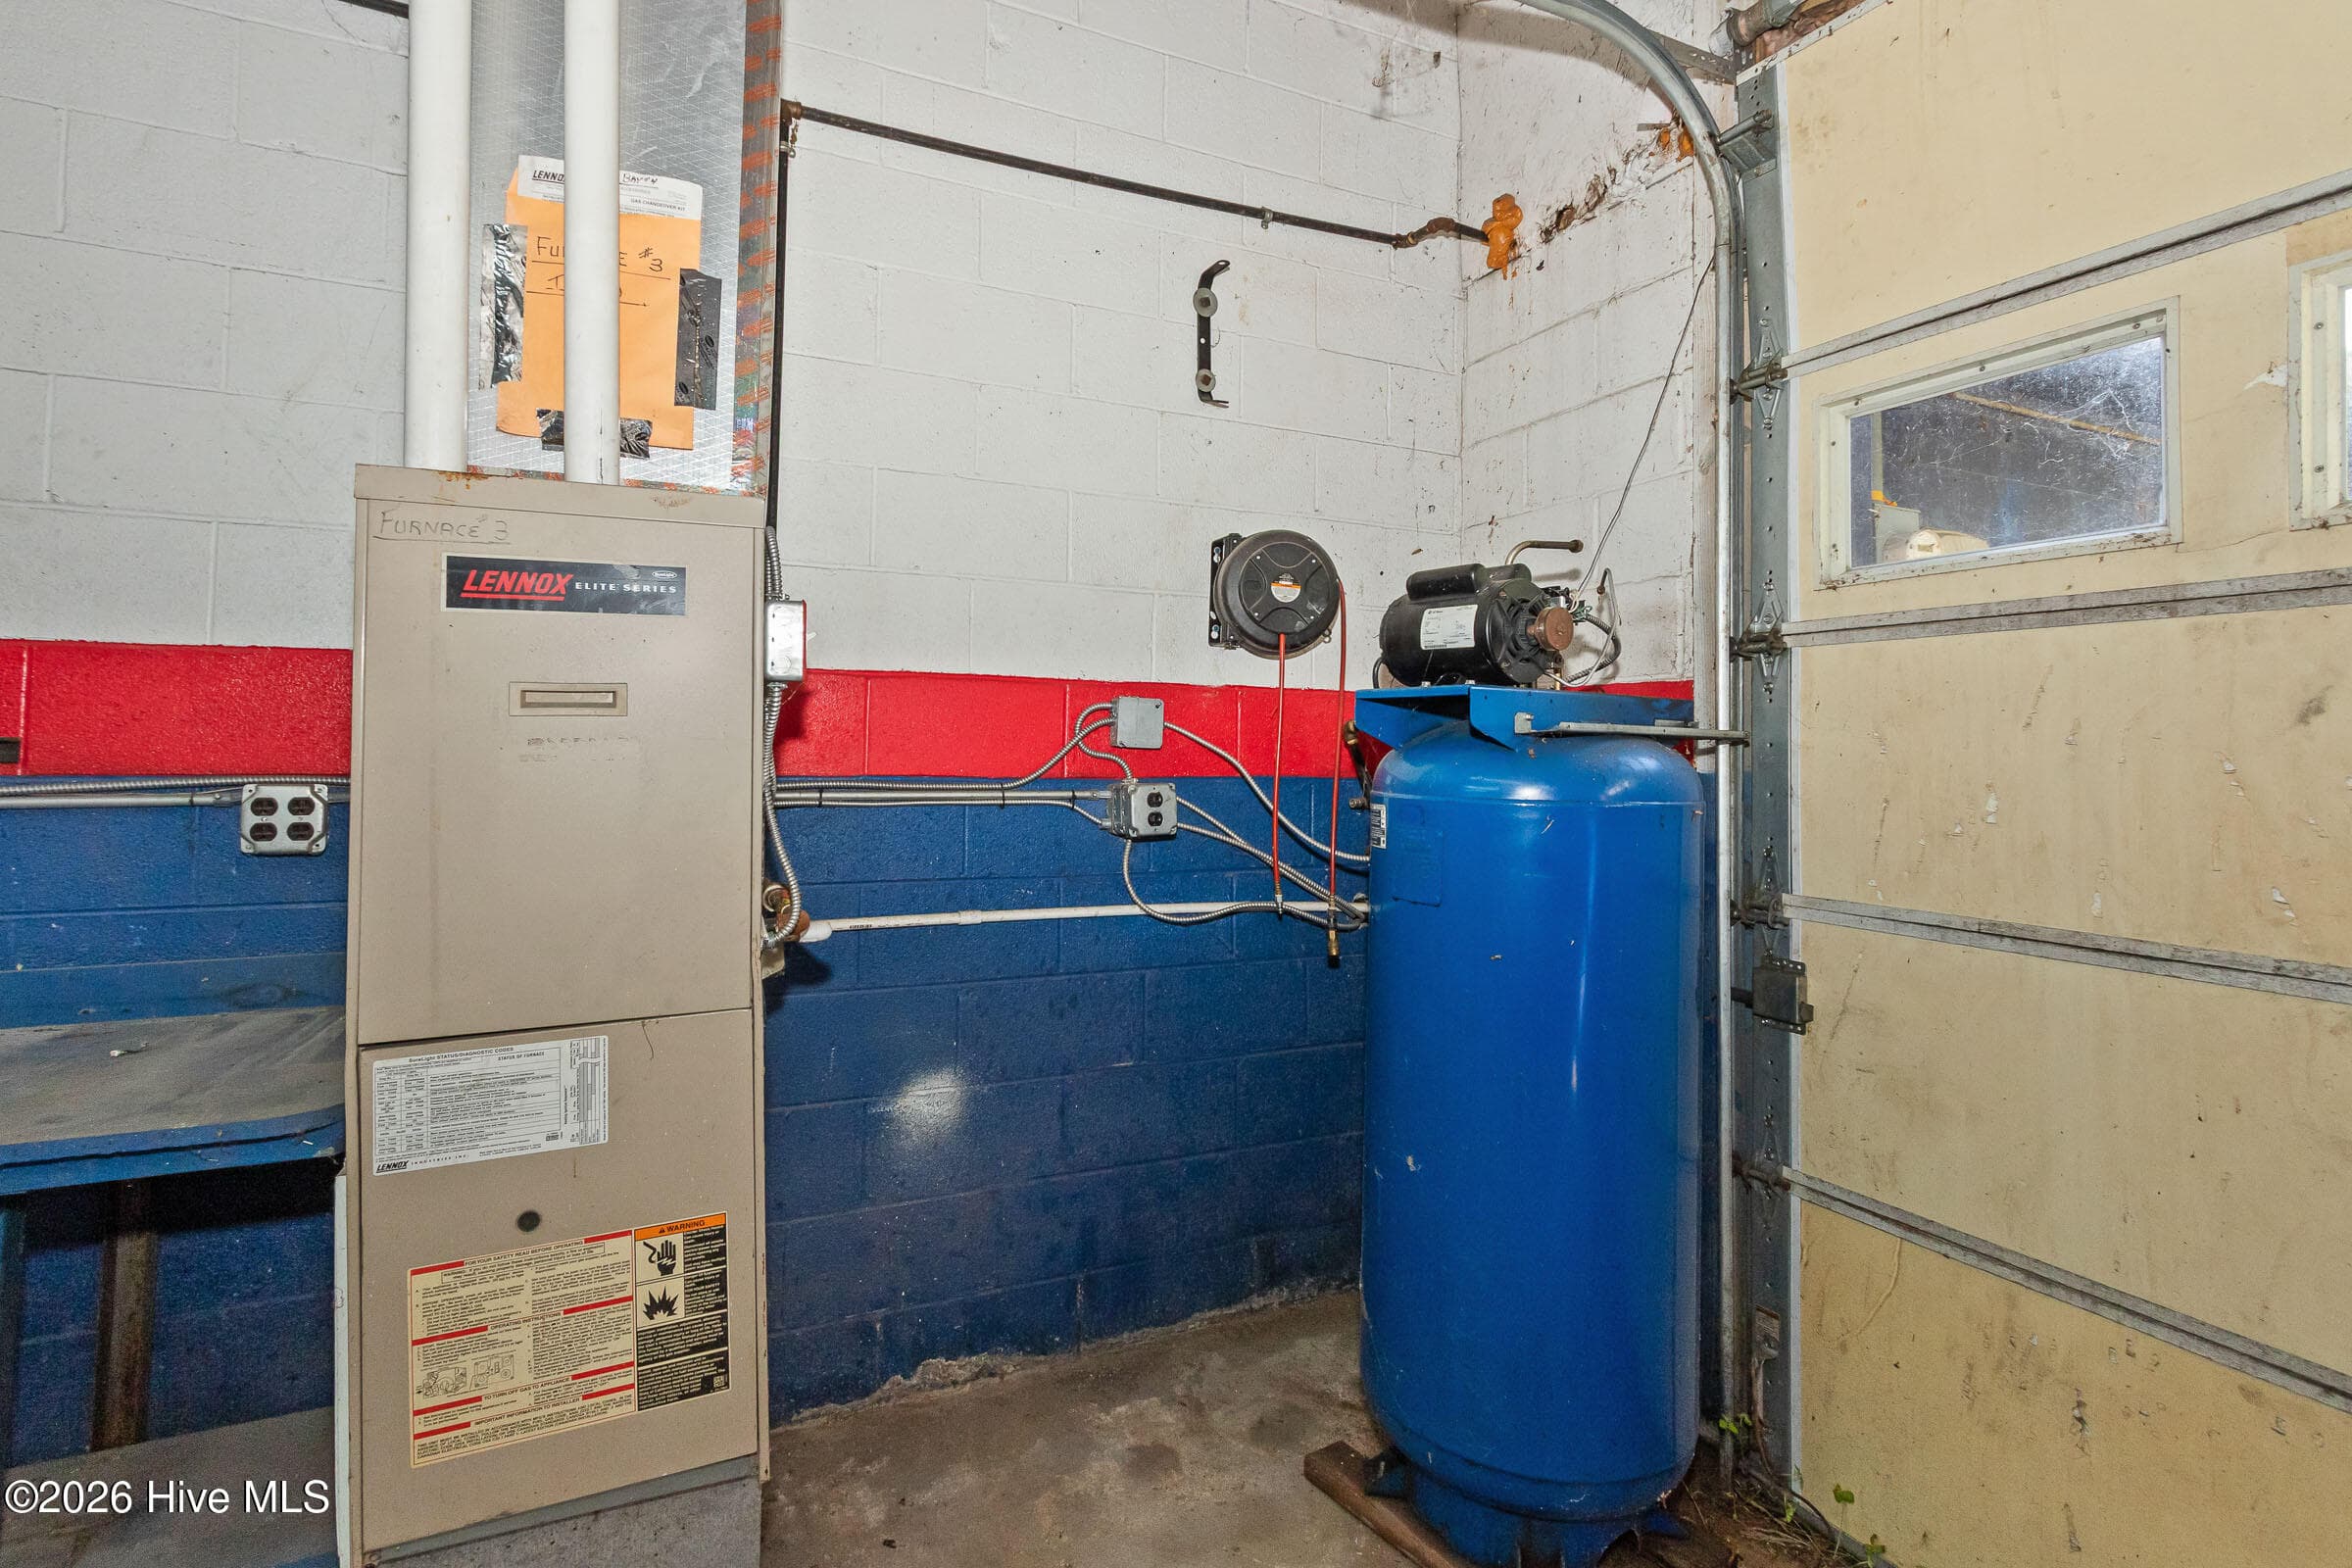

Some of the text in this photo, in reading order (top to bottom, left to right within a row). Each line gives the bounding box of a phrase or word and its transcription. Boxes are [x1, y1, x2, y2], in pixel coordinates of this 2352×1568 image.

[533, 170, 565, 182] LENNO
[379, 511, 479, 539] FURNACE
[462, 569, 574, 596] LENNOX
[622, 583, 677, 594] SERIES
[376, 1160, 409, 1171] LENNOX
[666, 1220, 706, 1232] WARNING
[490, 1320, 521, 1330] OPERATING
